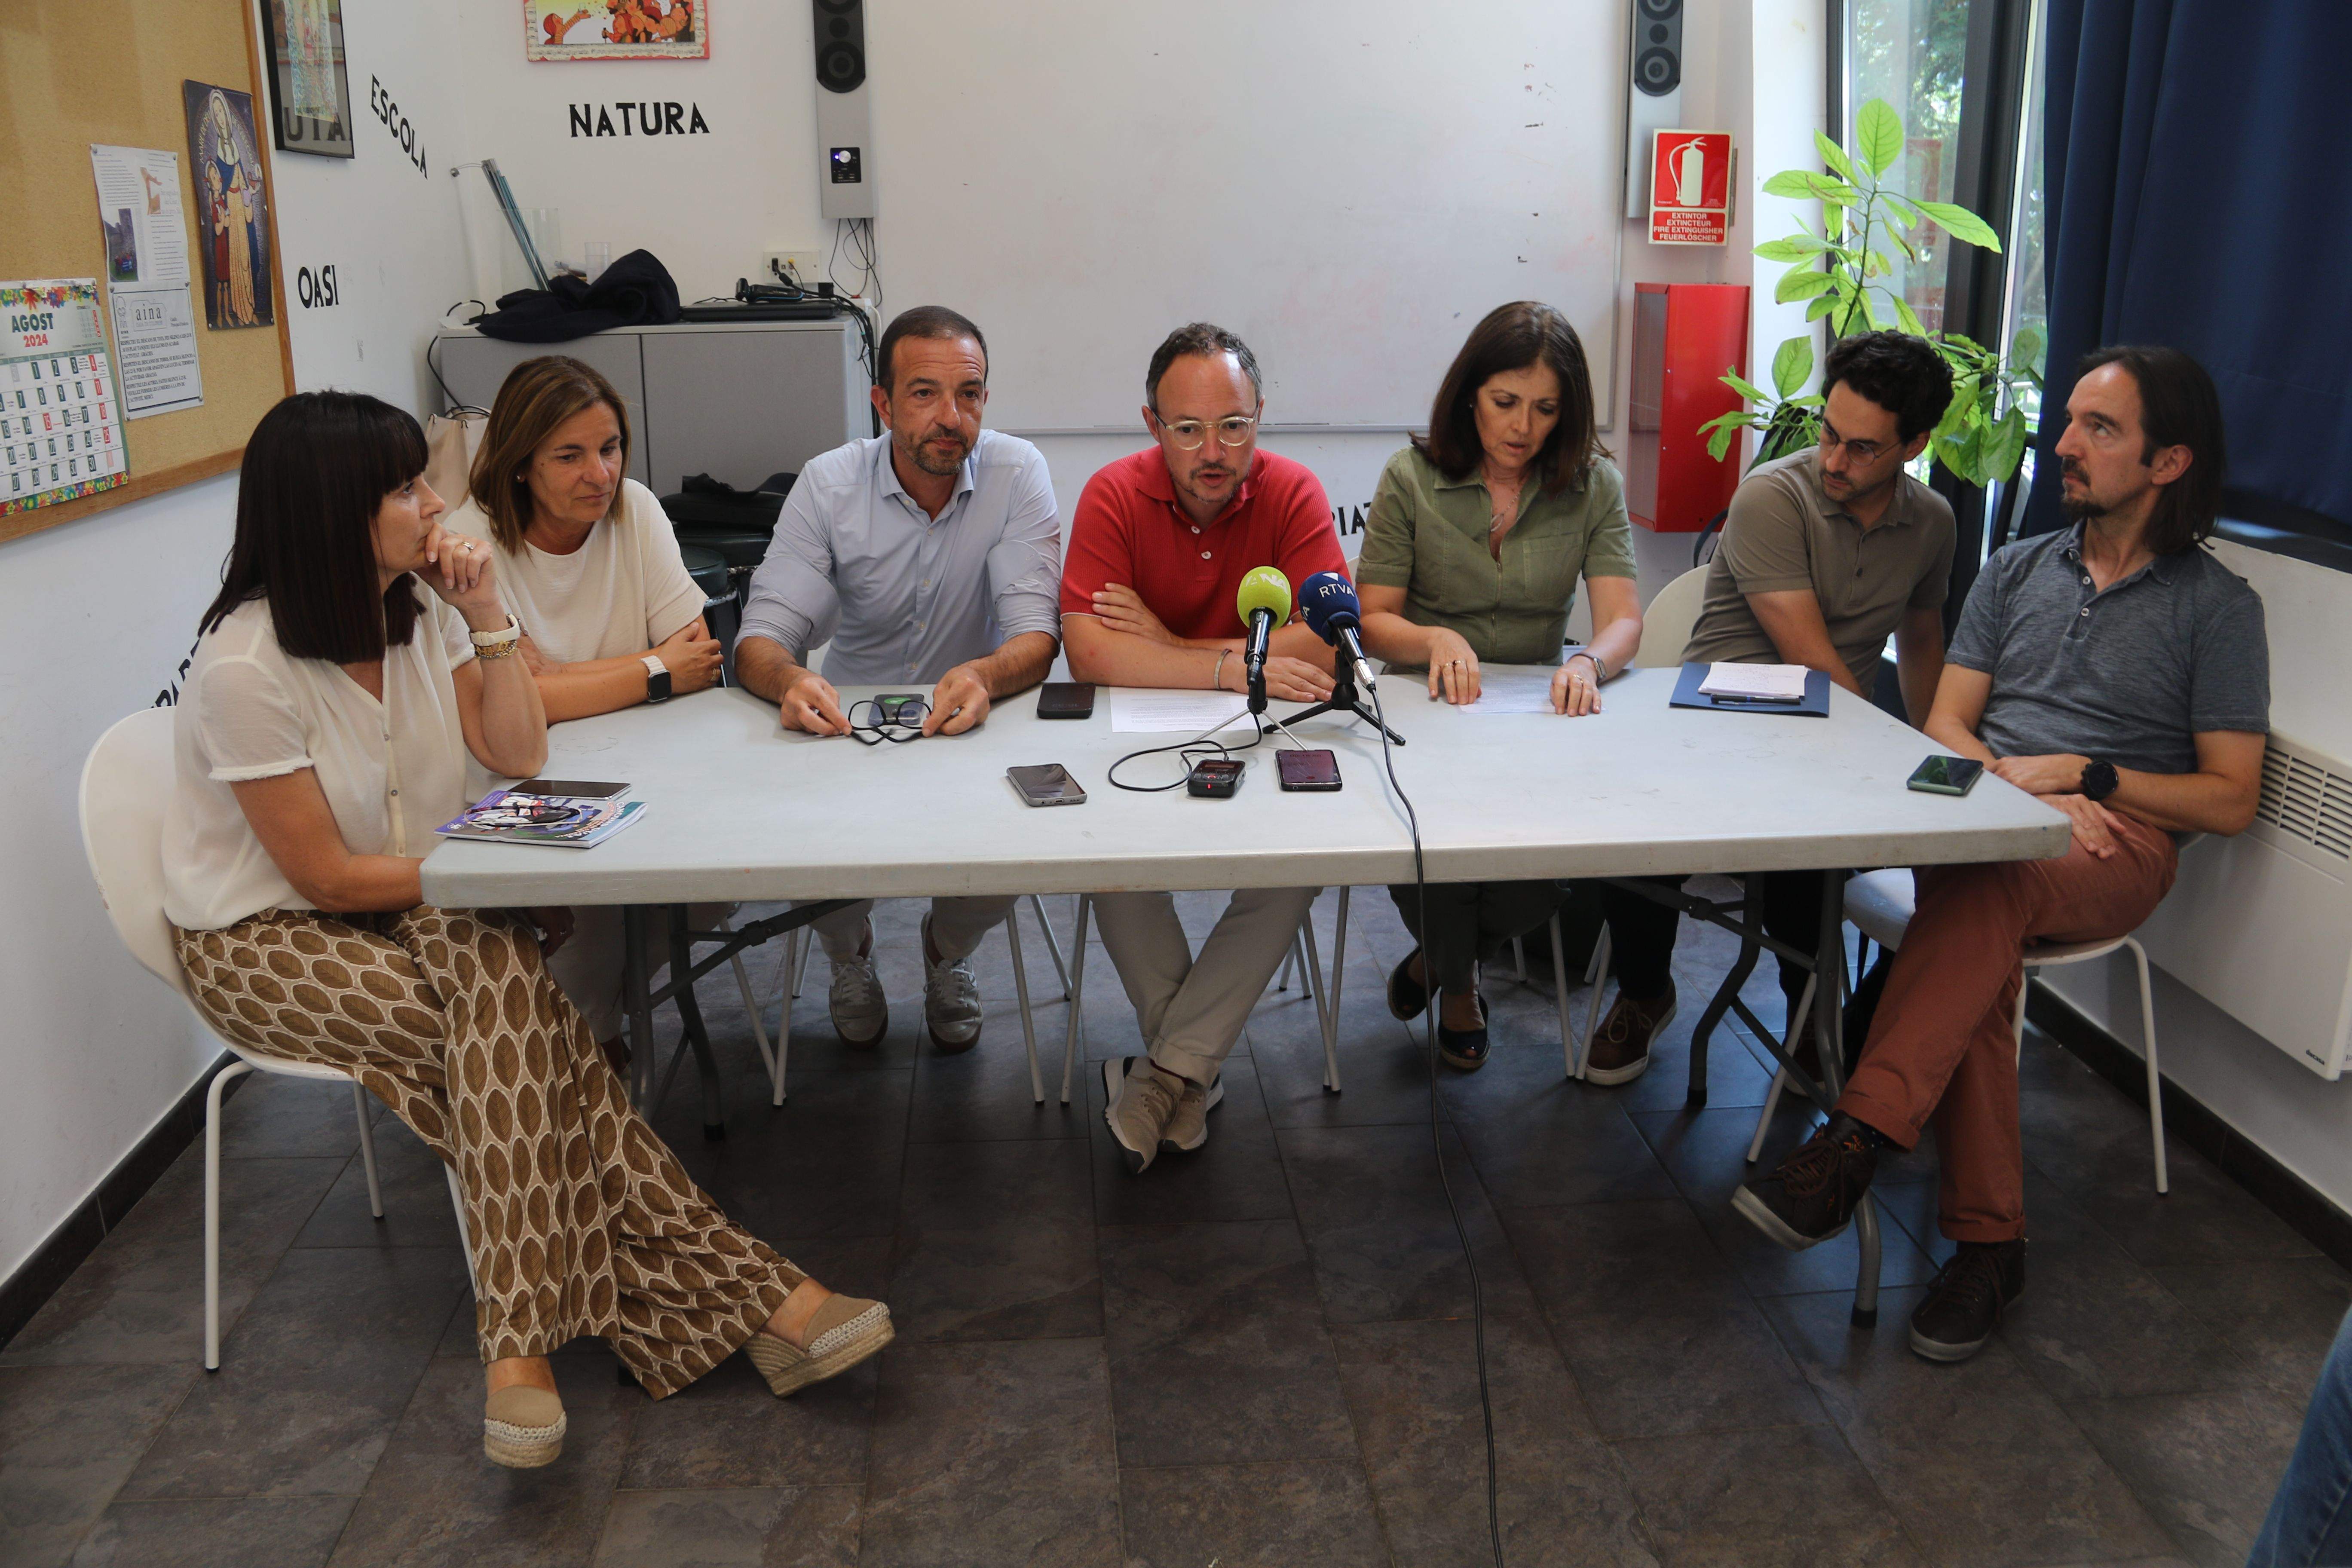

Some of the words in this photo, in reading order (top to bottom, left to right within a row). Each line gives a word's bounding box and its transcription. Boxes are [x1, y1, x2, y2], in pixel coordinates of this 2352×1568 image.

[371, 73, 428, 180] ESCOLA
[569, 102, 710, 138] NATURA
[1660, 233, 1717, 241] FEUERLÖSCHER
[298, 265, 339, 309] OASI
[12, 312, 53, 333] AGOST
[136, 303, 161, 321] aina
[23, 334, 48, 348] 2024
[52, 361, 59, 376] 2
[71, 358, 78, 373] 3
[17, 392, 24, 408] 7
[39, 389, 45, 404] 8
[59, 386, 65, 401] 9
[76, 383, 84, 398] 10
[95, 380, 102, 395] 11
[3, 421, 10, 437] 13
[23, 417, 32, 433] 14
[44, 414, 52, 430] 15
[64, 411, 71, 426] 16
[82, 407, 89, 422] 17
[8, 448, 16, 464] 20
[29, 444, 37, 459] 21
[48, 439, 56, 455] 22
[67, 435, 74, 451] 23
[85, 432, 92, 447] 24
[103, 428, 110, 443] 25
[12, 475, 19, 490] 27
[33, 469, 40, 486] 28
[52, 465, 58, 481] 29
[70, 460, 77, 476] 30
[89, 456, 96, 472] 31
[1319, 583, 1355, 598] RTVA
